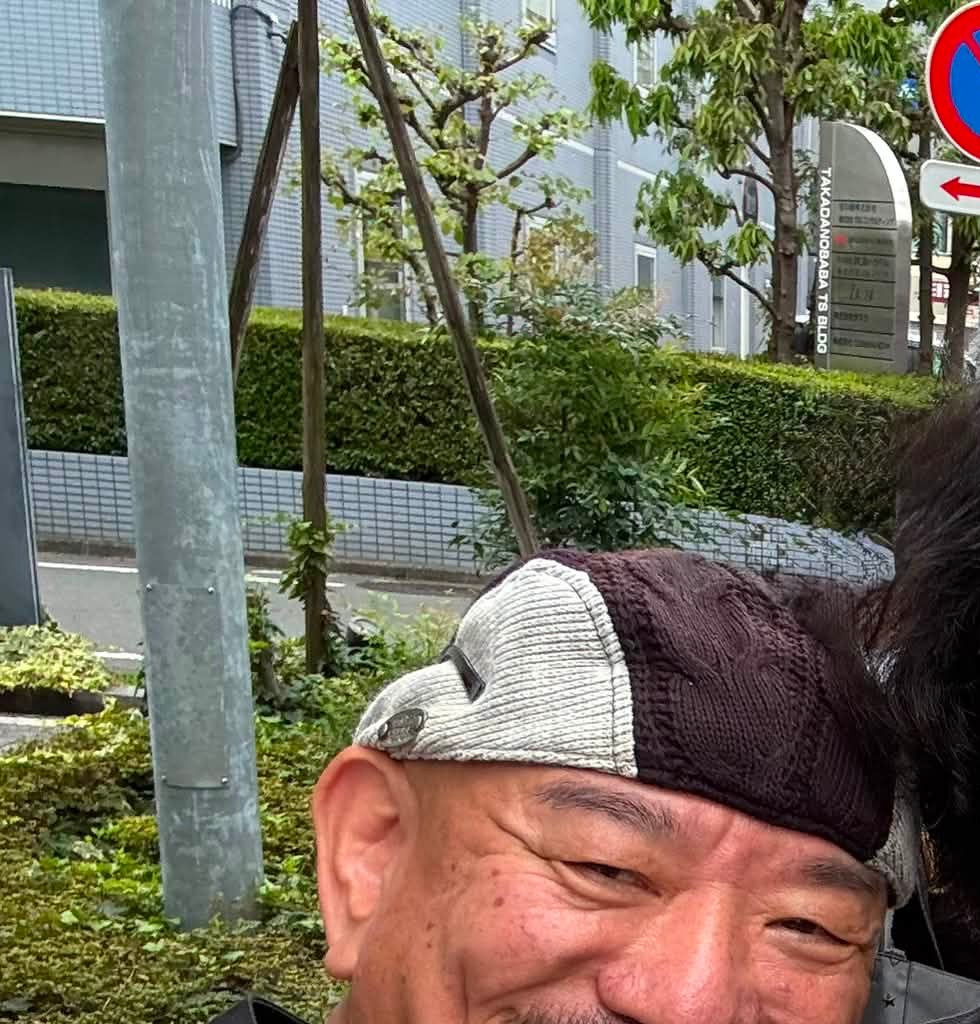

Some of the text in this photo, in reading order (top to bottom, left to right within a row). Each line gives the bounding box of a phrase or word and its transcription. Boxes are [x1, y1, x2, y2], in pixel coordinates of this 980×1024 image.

[816, 167, 832, 355] TAKADANOBABA TS BLDG
